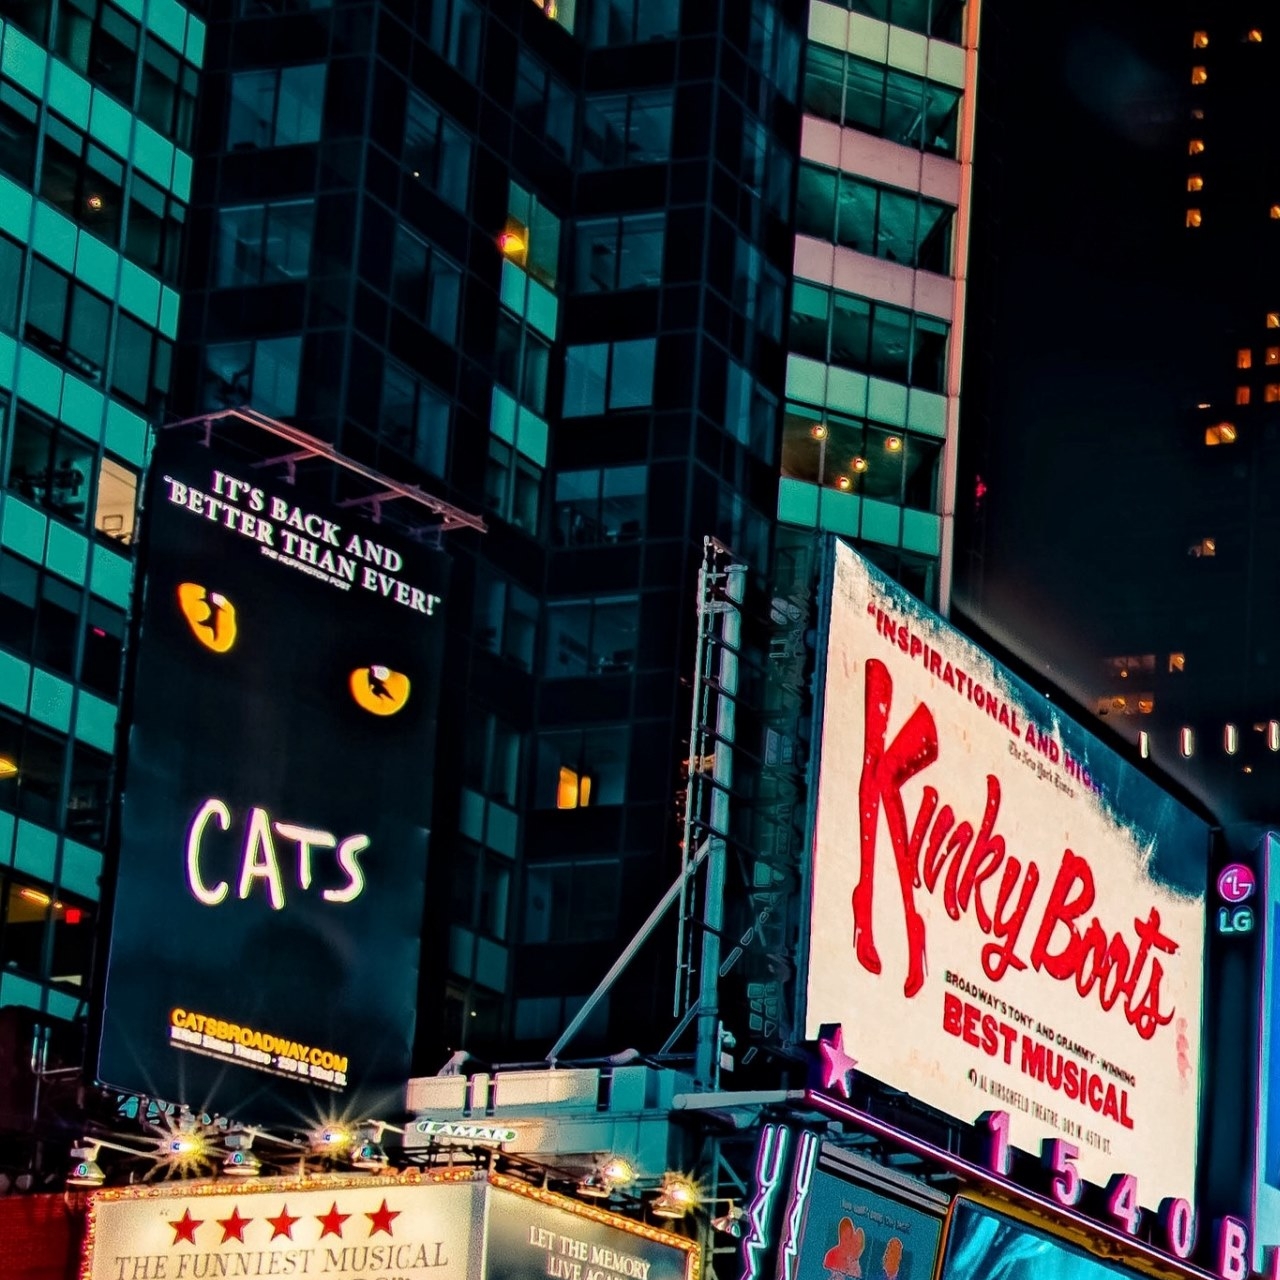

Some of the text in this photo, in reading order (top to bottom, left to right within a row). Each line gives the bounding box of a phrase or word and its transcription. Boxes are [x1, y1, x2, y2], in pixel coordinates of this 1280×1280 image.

[212, 470, 403, 572] IT'S BACK AND
[280, 529, 358, 582] THAN
[1025, 723, 1060, 764] AND
[183, 798, 371, 910] CATS
[852, 657, 1180, 1041] Kinky Boots
[1218, 908, 1252, 933] LG
[945, 970, 1007, 1016] BROADWAY'S
[1036, 1022, 1054, 1042] AND
[170, 1008, 348, 1073] CATSBROADWAY.COM
[943, 991, 1134, 1130] BEST MUSICAL
[979, 1074, 988, 1093] AL
[114, 1241, 449, 1280] THE FUNNIEST MUSICAL
[529, 1226, 556, 1250] LET
[559, 1236, 588, 1261] THE
